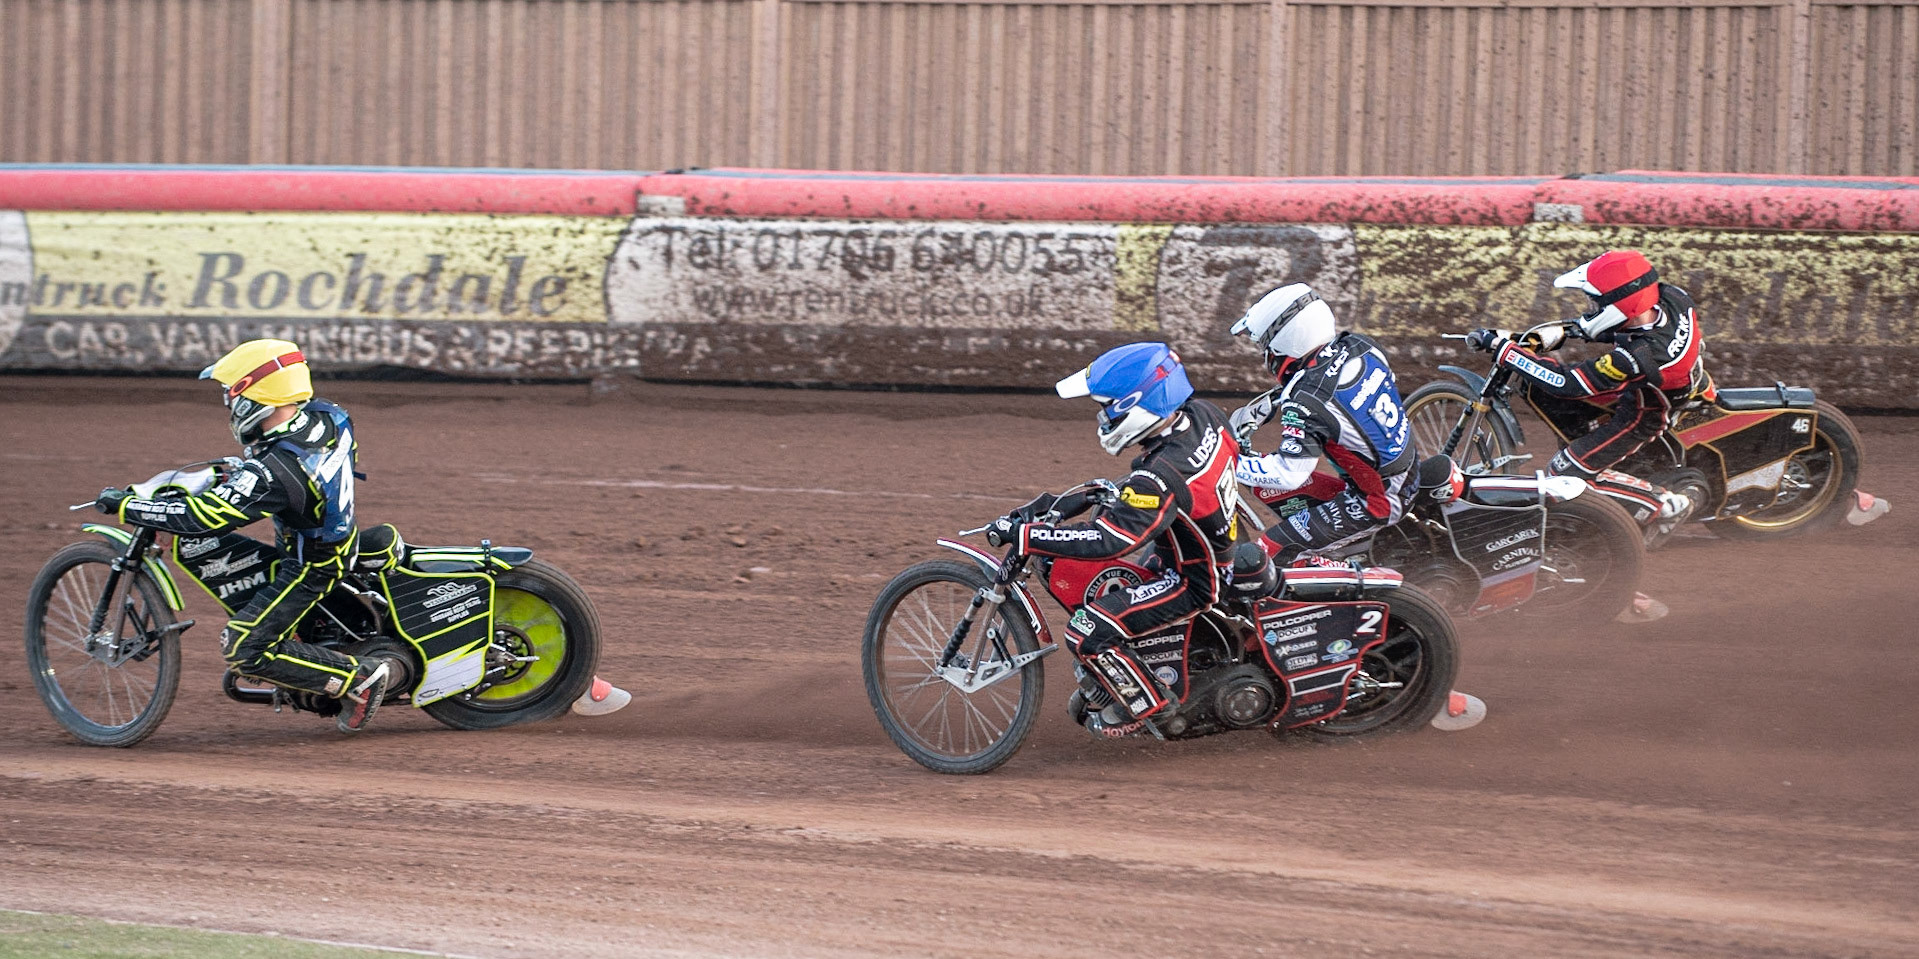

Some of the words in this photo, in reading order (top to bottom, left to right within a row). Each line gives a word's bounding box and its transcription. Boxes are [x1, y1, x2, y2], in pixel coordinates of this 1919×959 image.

[185, 251, 571, 317] Rochdale
[1516, 356, 1565, 387] BETARD
[1375, 393, 1398, 428] 3
[1791, 418, 1809, 434] 46
[1030, 528, 1103, 542] POLCOPPER
[1493, 548, 1541, 571] CARNIVAL
[219, 571, 267, 599] JHM
[1087, 576, 1105, 598] BELLE
[1105, 570, 1122, 580] VUE
[1263, 609, 1332, 630] POLCOPPER
[1356, 611, 1383, 633] 2
[1278, 623, 1317, 639] DOCUFY
[1102, 719, 1144, 737] dayton
